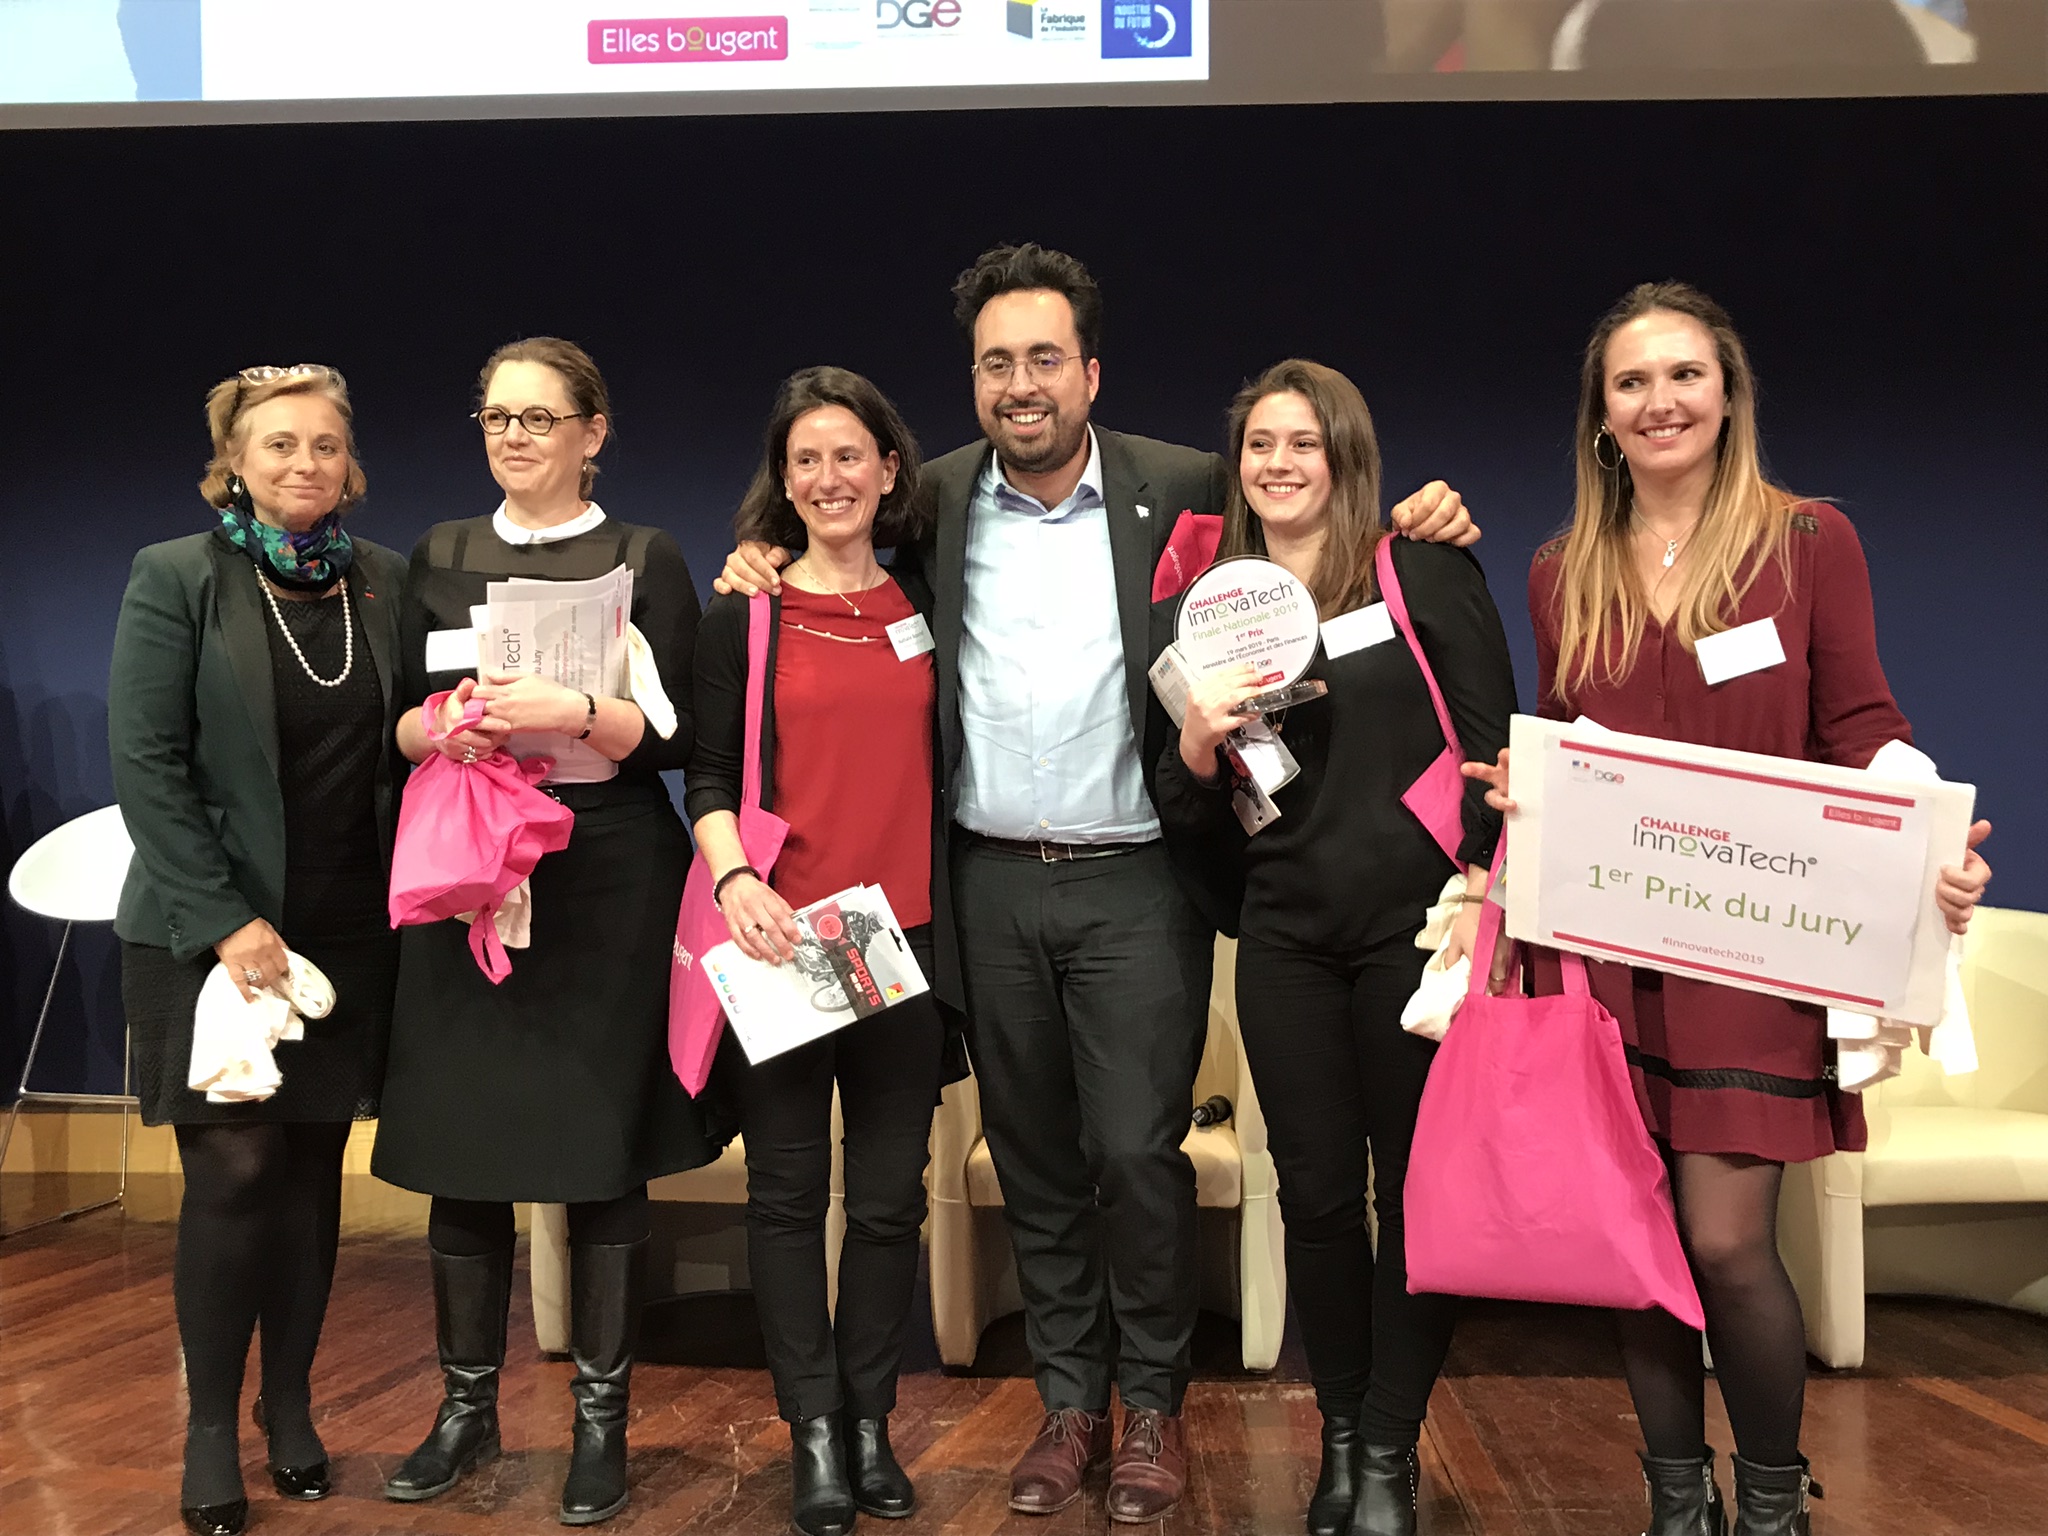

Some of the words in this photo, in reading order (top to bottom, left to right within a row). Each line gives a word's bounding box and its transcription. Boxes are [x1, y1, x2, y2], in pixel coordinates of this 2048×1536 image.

[1041, 13, 1085, 25] Fabrique
[602, 27, 660, 53] Elles
[666, 26, 778, 56] bougent
[1189, 587, 1244, 611] CHALLENGE
[1192, 626, 1222, 642] Finale
[1223, 610, 1271, 632] Nationale
[1273, 601, 1299, 617] 2019
[1235, 632, 1246, 642] 1er
[1248, 628, 1264, 639] Prix
[532, 649, 544, 666] Jury
[1202, 659, 1227, 670] Ministère
[1227, 656, 1235, 664] de
[1273, 641, 1283, 649] des
[1284, 635, 1308, 646] Finances
[1235, 645, 1248, 654] mars
[1248, 639, 1263, 650] 2019
[1266, 636, 1280, 645] Paris
[1640, 816, 1731, 842] CHALLENGE
[1588, 864, 1633, 890] 1er
[1645, 875, 1712, 913] Prix
[1724, 892, 1770, 923] du
[1782, 903, 1863, 945] Jury
[673, 934, 693, 971] ugent
[846, 947, 882, 1007] SPORTS
